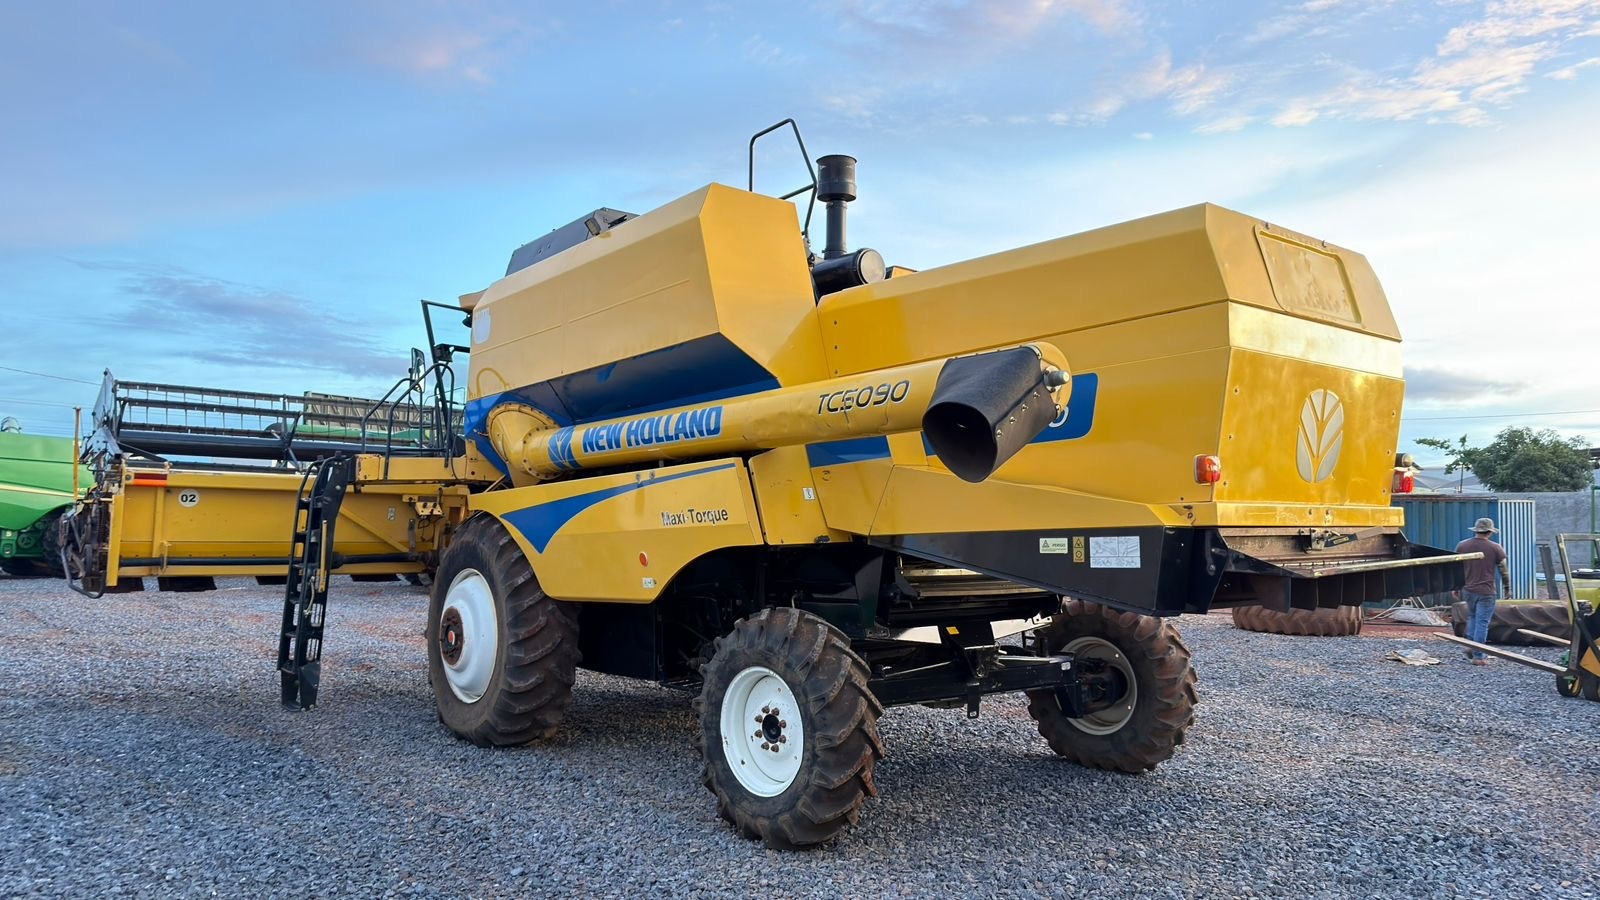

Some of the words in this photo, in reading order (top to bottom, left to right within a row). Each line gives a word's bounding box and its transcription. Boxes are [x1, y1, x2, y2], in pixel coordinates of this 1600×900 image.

[582, 421, 626, 454] NEW
[625, 405, 724, 447] HOLLAND
[180, 494, 197, 503] 02
